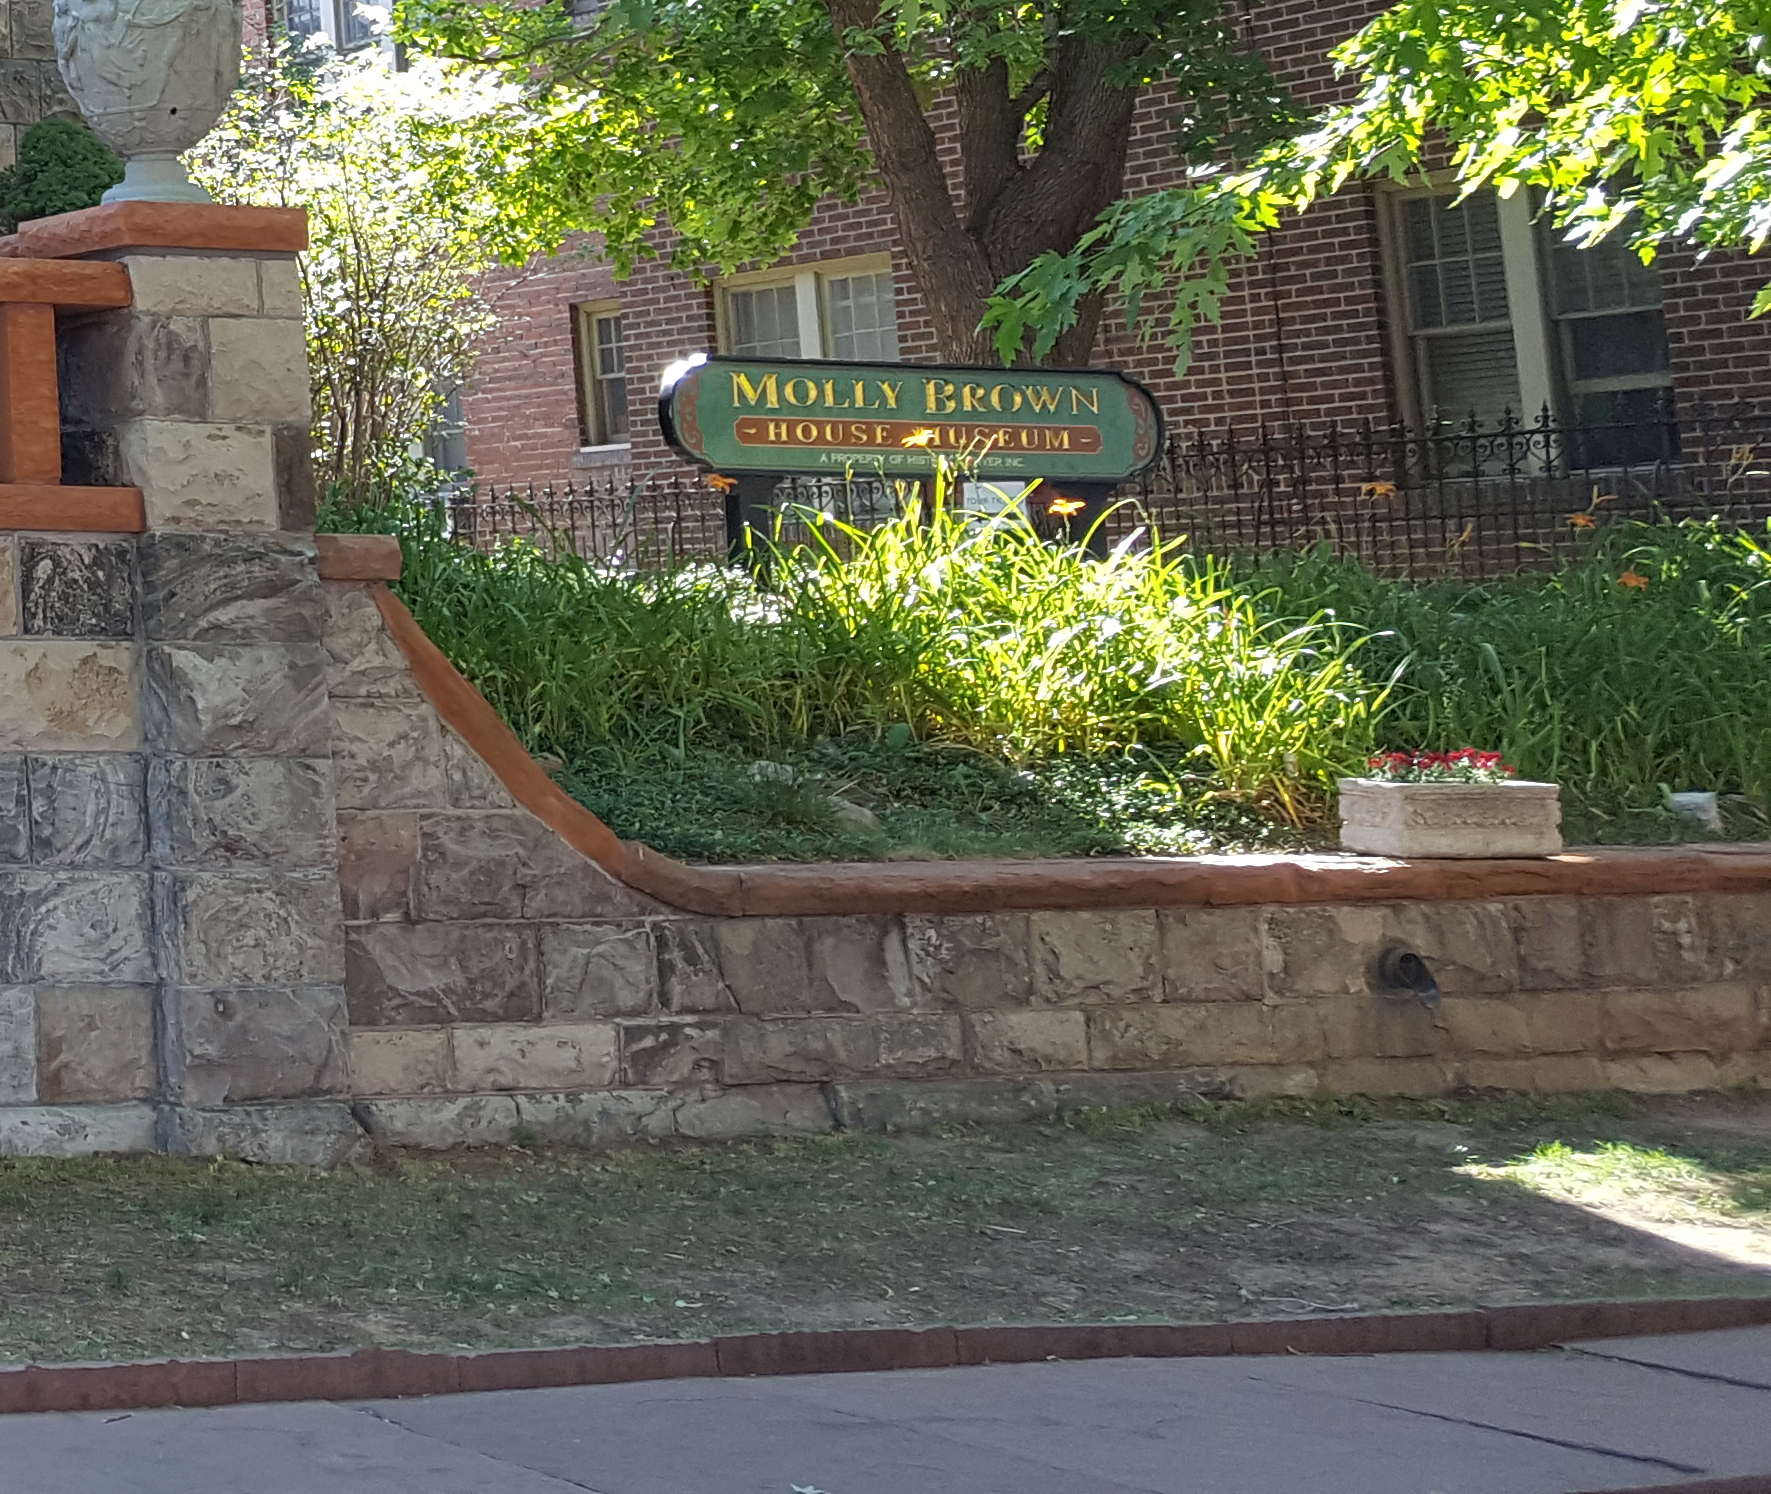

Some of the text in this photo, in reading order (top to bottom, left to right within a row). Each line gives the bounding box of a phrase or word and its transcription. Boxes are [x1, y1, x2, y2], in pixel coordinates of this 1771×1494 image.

[729, 372, 1099, 415] MOLLY BROWN
[767, 420, 892, 444] HOUSE
[819, 453, 828, 463] A
[888, 455, 904, 464] OF
